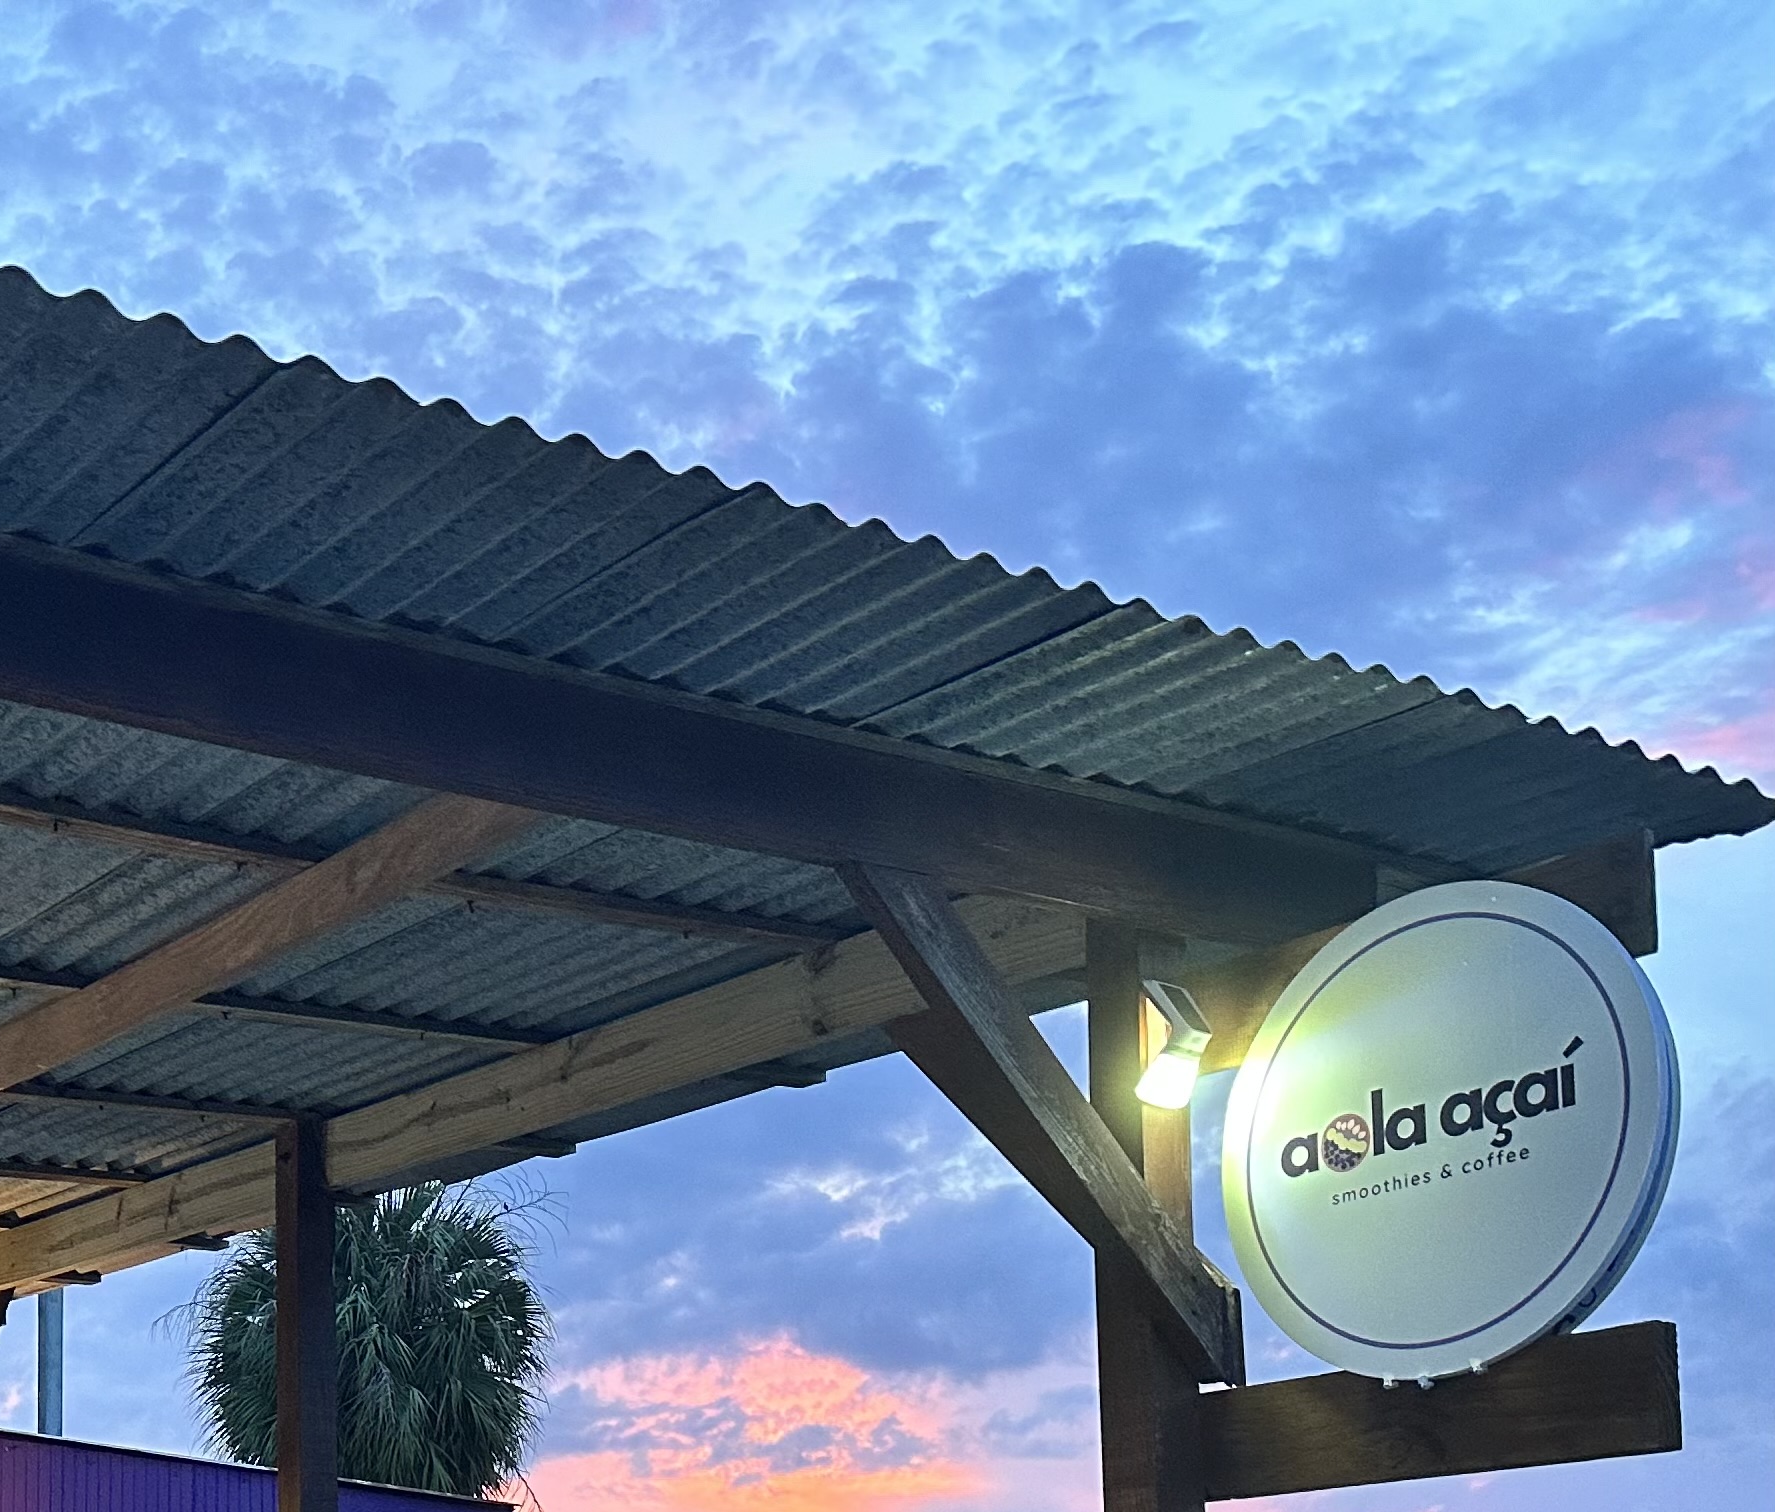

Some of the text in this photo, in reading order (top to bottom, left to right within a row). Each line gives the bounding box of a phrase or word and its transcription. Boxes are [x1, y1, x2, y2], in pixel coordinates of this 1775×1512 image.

[1440, 1035, 1584, 1148] açaí
[1331, 1147, 1531, 1206] smoothies & coffee
